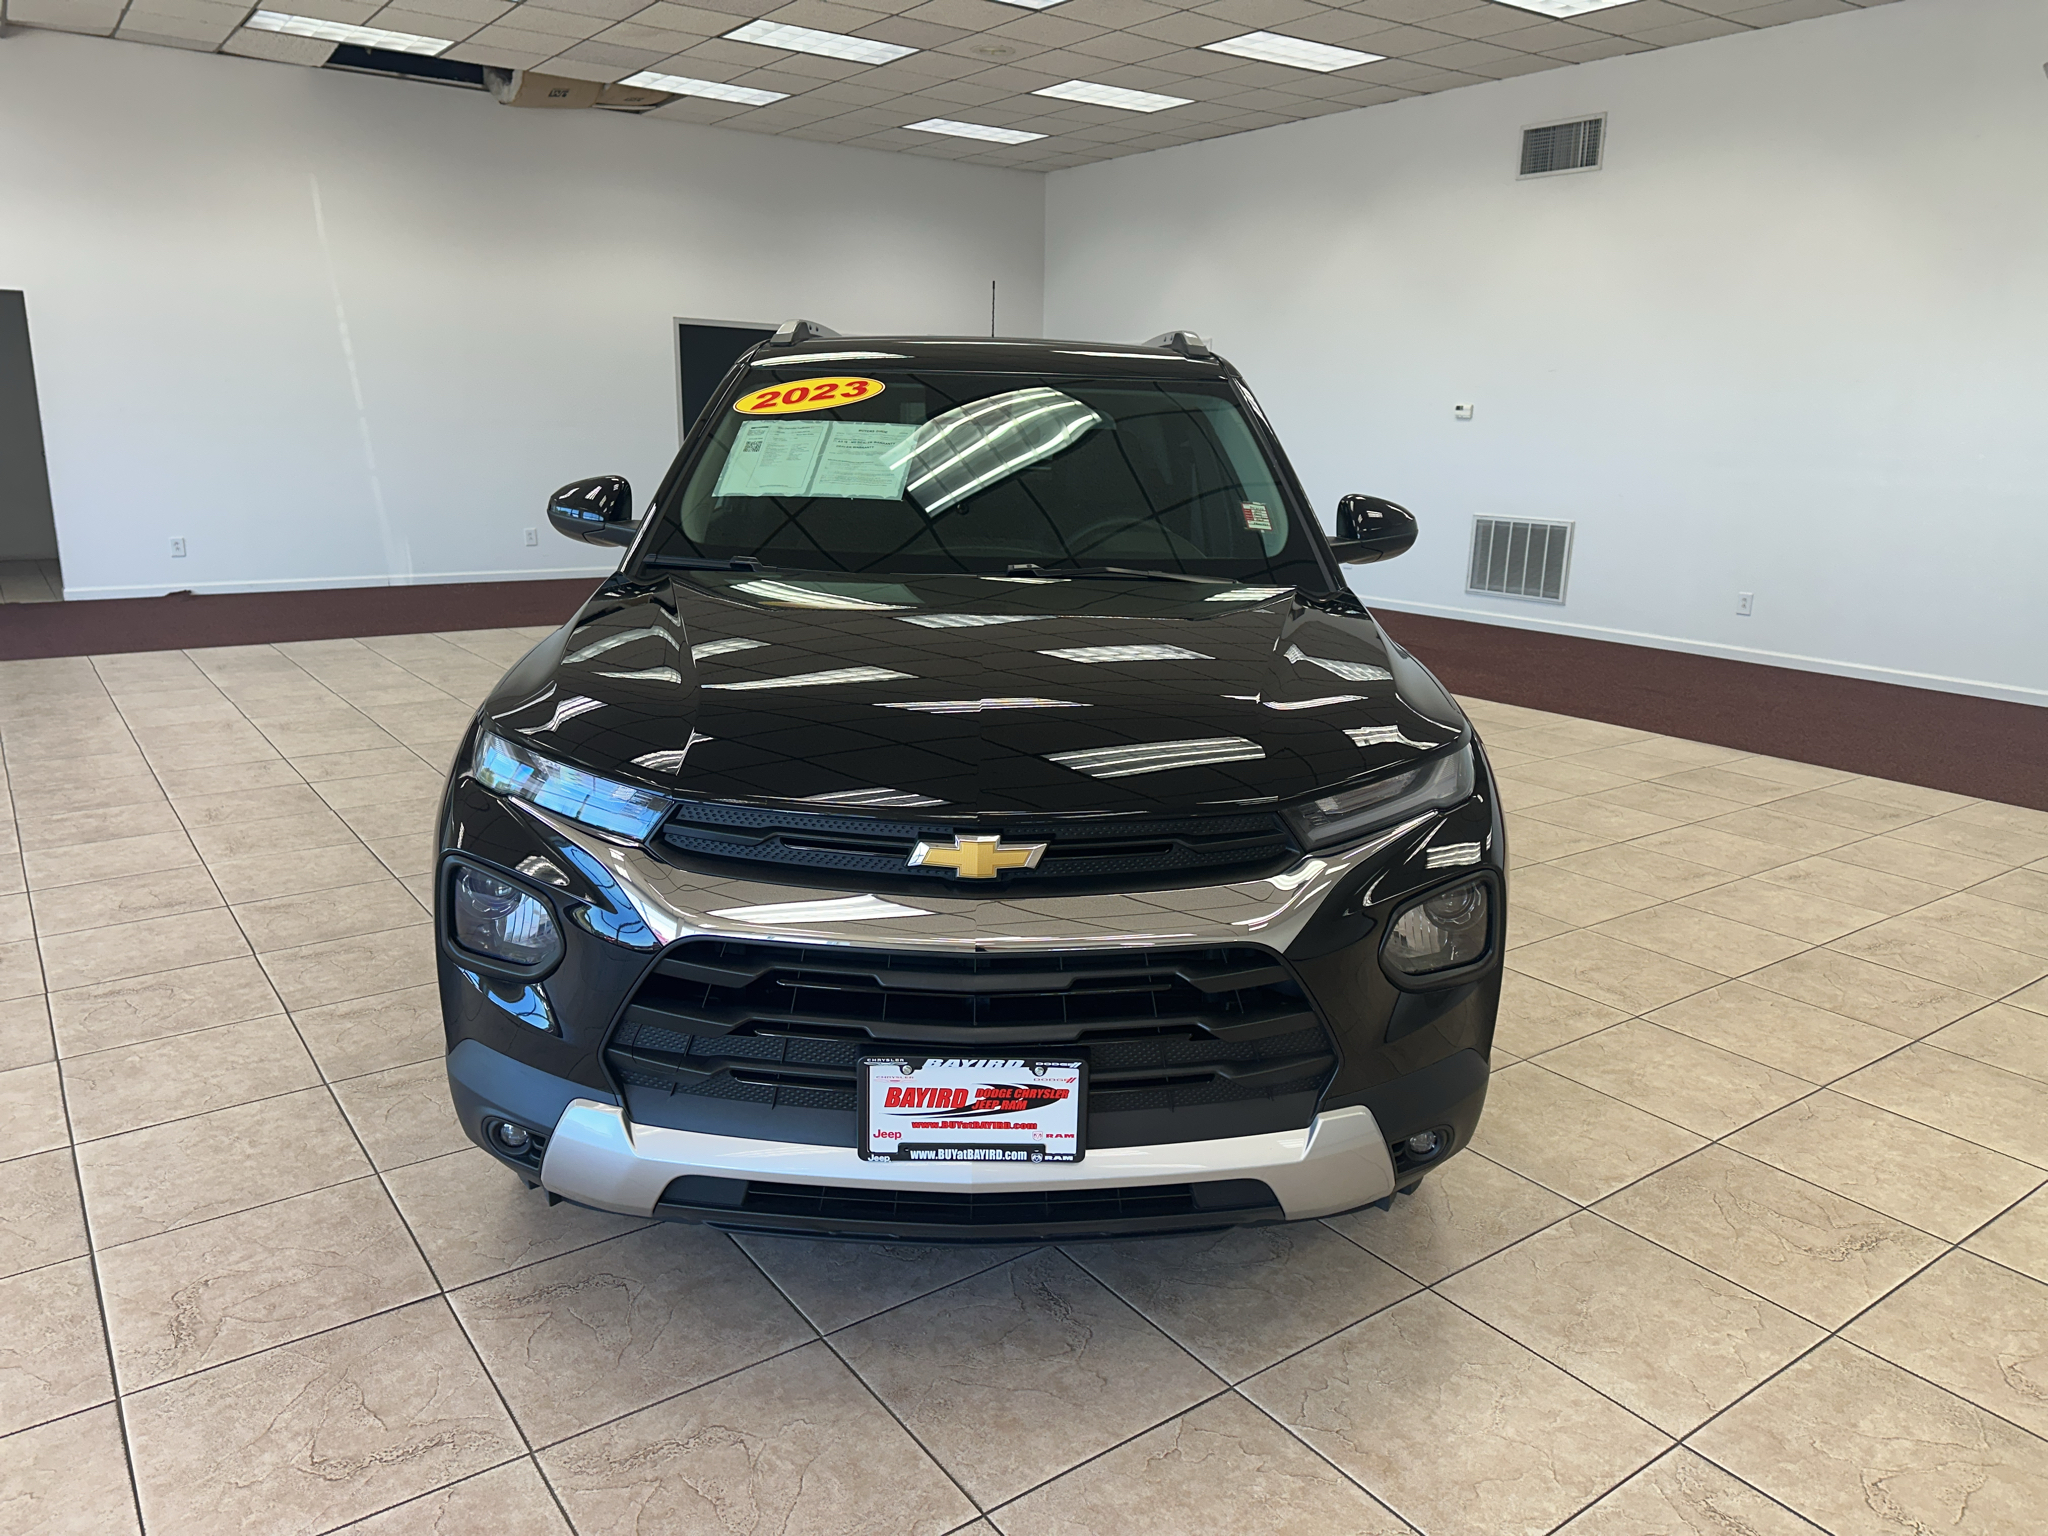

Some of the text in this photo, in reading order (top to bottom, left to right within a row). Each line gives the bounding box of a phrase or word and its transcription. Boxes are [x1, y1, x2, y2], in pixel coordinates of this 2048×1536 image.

[750, 381, 869, 410] 2023
[922, 1058, 1025, 1068] BAYIRD
[884, 1087, 969, 1109] BAYIRD
[975, 1088, 1070, 1100] DODGE CHRYSLER
[972, 1100, 1028, 1110] JEEP RAM
[911, 1120, 1038, 1130] www.BUYatBAYIRD.com
[873, 1129, 902, 1140] Jeep
[868, 1154, 892, 1163] Jeep
[910, 1149, 1028, 1161] www.BUYatBAYIRD.com
